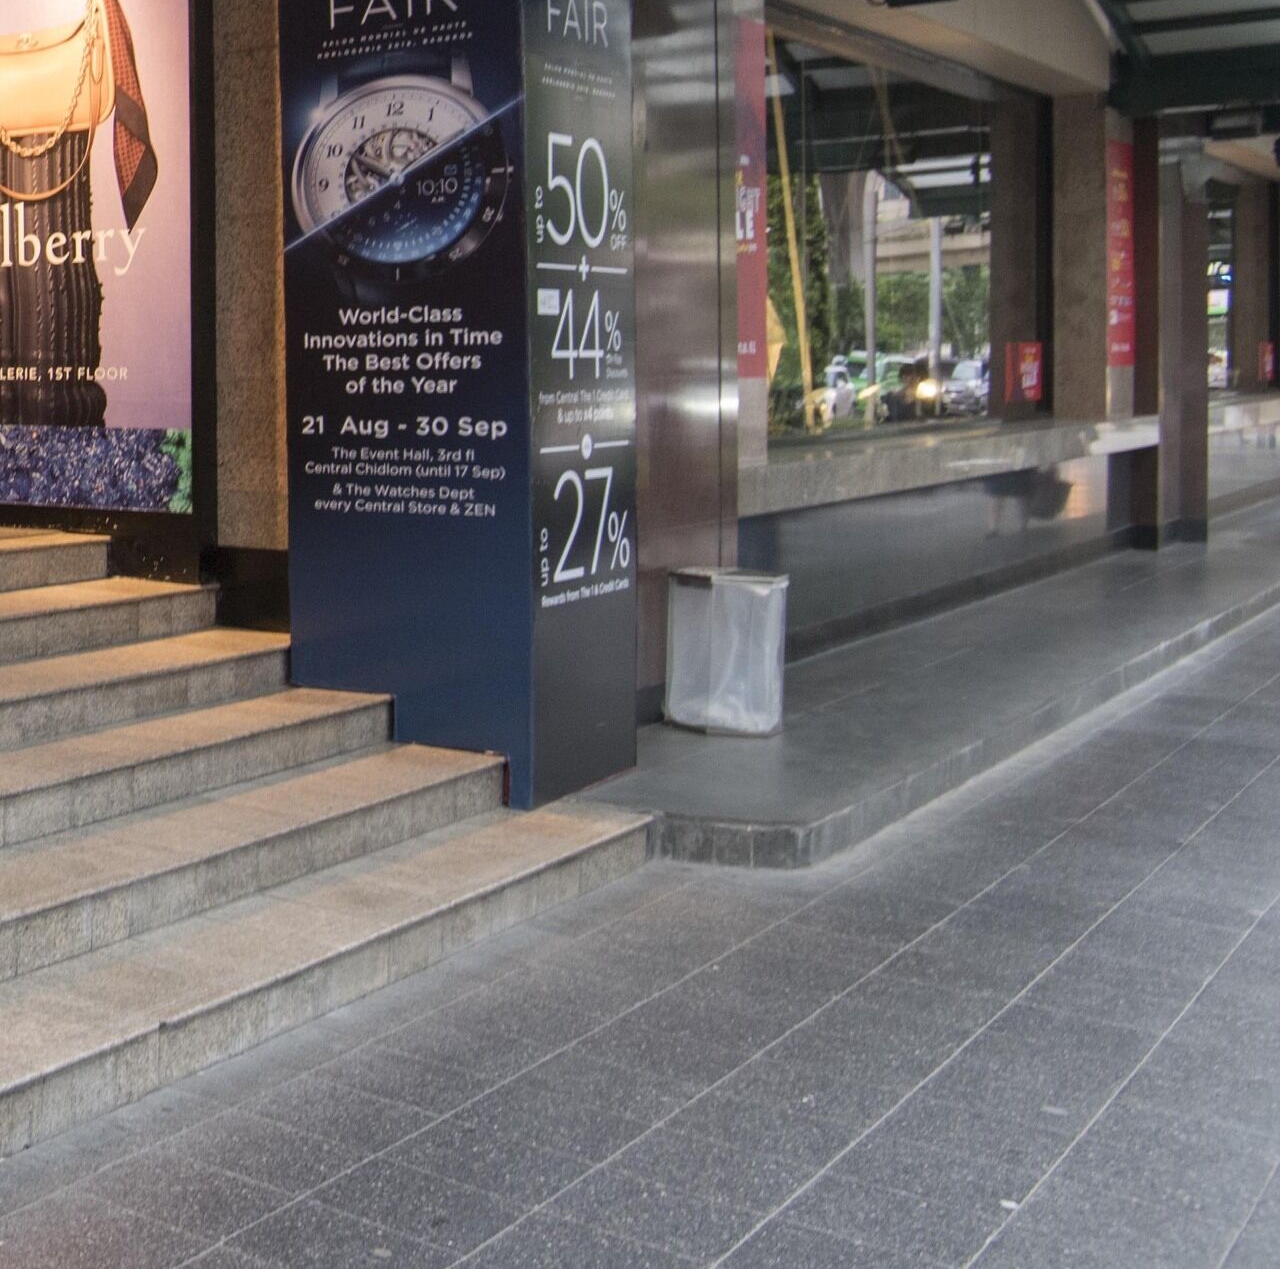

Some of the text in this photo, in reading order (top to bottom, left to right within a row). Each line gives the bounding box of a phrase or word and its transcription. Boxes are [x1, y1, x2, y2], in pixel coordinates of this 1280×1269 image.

[386, 101, 405, 117] 12
[352, 115, 365, 129] 11
[326, 145, 343, 158] 10
[319, 178, 329, 192] 9
[736, 210, 754, 240] LE
[610, 234, 628, 251] OFF
[339, 305, 463, 326] World-Class
[303, 327, 504, 350] Innovations in Time
[322, 352, 482, 372] The Best Offers
[47, 366, 73, 380] 1ST
[77, 366, 128, 380] FLOOR
[345, 376, 458, 394] of the Year
[301, 415, 325, 435] 21
[340, 415, 390, 439] Aug
[415, 416, 449, 436] 30
[457, 416, 508, 440] Sep
[331, 446, 357, 460] The
[360, 447, 400, 461] Event
[403, 448, 434, 462] Hall,
[437, 448, 462, 462] 3rd
[304, 461, 506, 480] Central Chidlom (until 17 Sep)
[332, 482, 475, 501] & The Watches Dept
[314, 499, 496, 517] every Central Store & ZEN
[540, 528, 550, 587] up to
